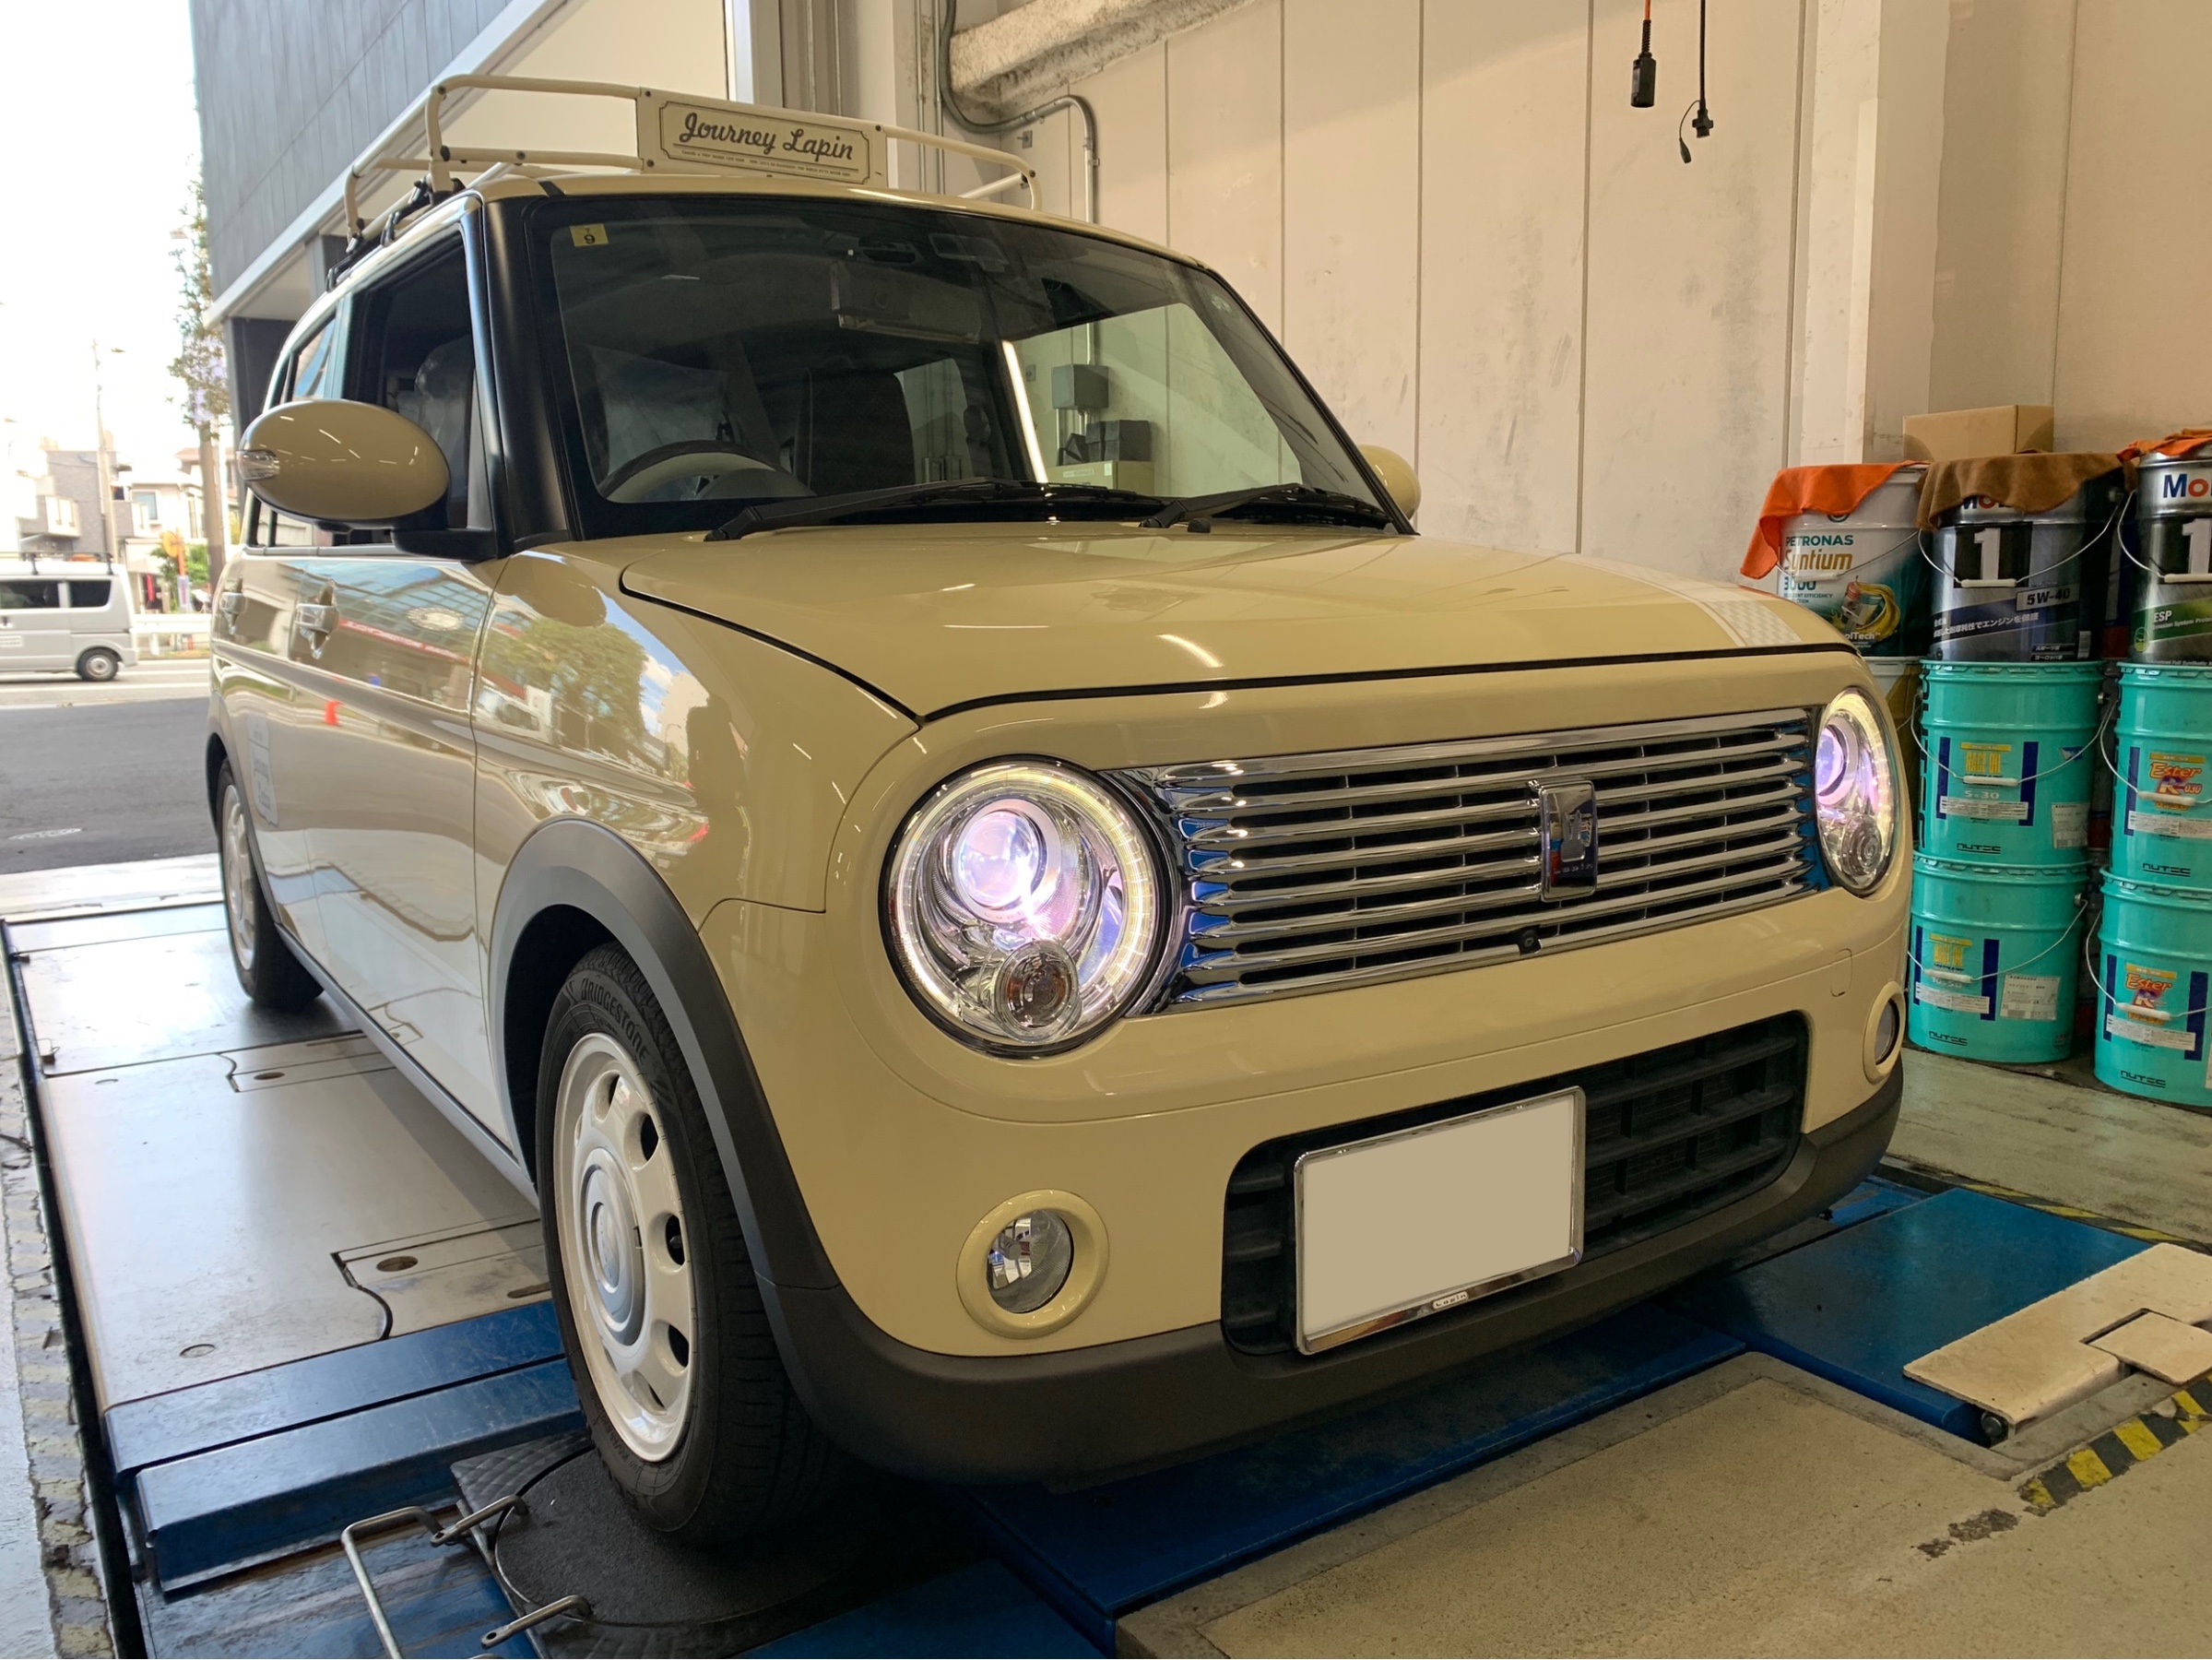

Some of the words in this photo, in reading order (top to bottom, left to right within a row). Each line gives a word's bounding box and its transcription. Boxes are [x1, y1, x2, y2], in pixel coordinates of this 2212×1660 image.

[680, 113, 776, 155] Journey
[783, 128, 853, 161] Lapin
[584, 234, 596, 244] 9
[2163, 473, 2212, 498] Mo
[1785, 535, 1853, 547] PETRONAS
[2182, 518, 2211, 574] 1
[1784, 549, 1853, 573] Syntium
[1974, 528, 2001, 580] 1
[2027, 587, 2071, 606] 5W-40
[2153, 610, 2172, 622] ESP
[2149, 761, 2202, 779] Ester
[2126, 974, 2172, 992] Ester
[581, 978, 651, 1065] BRIDGESTONE
